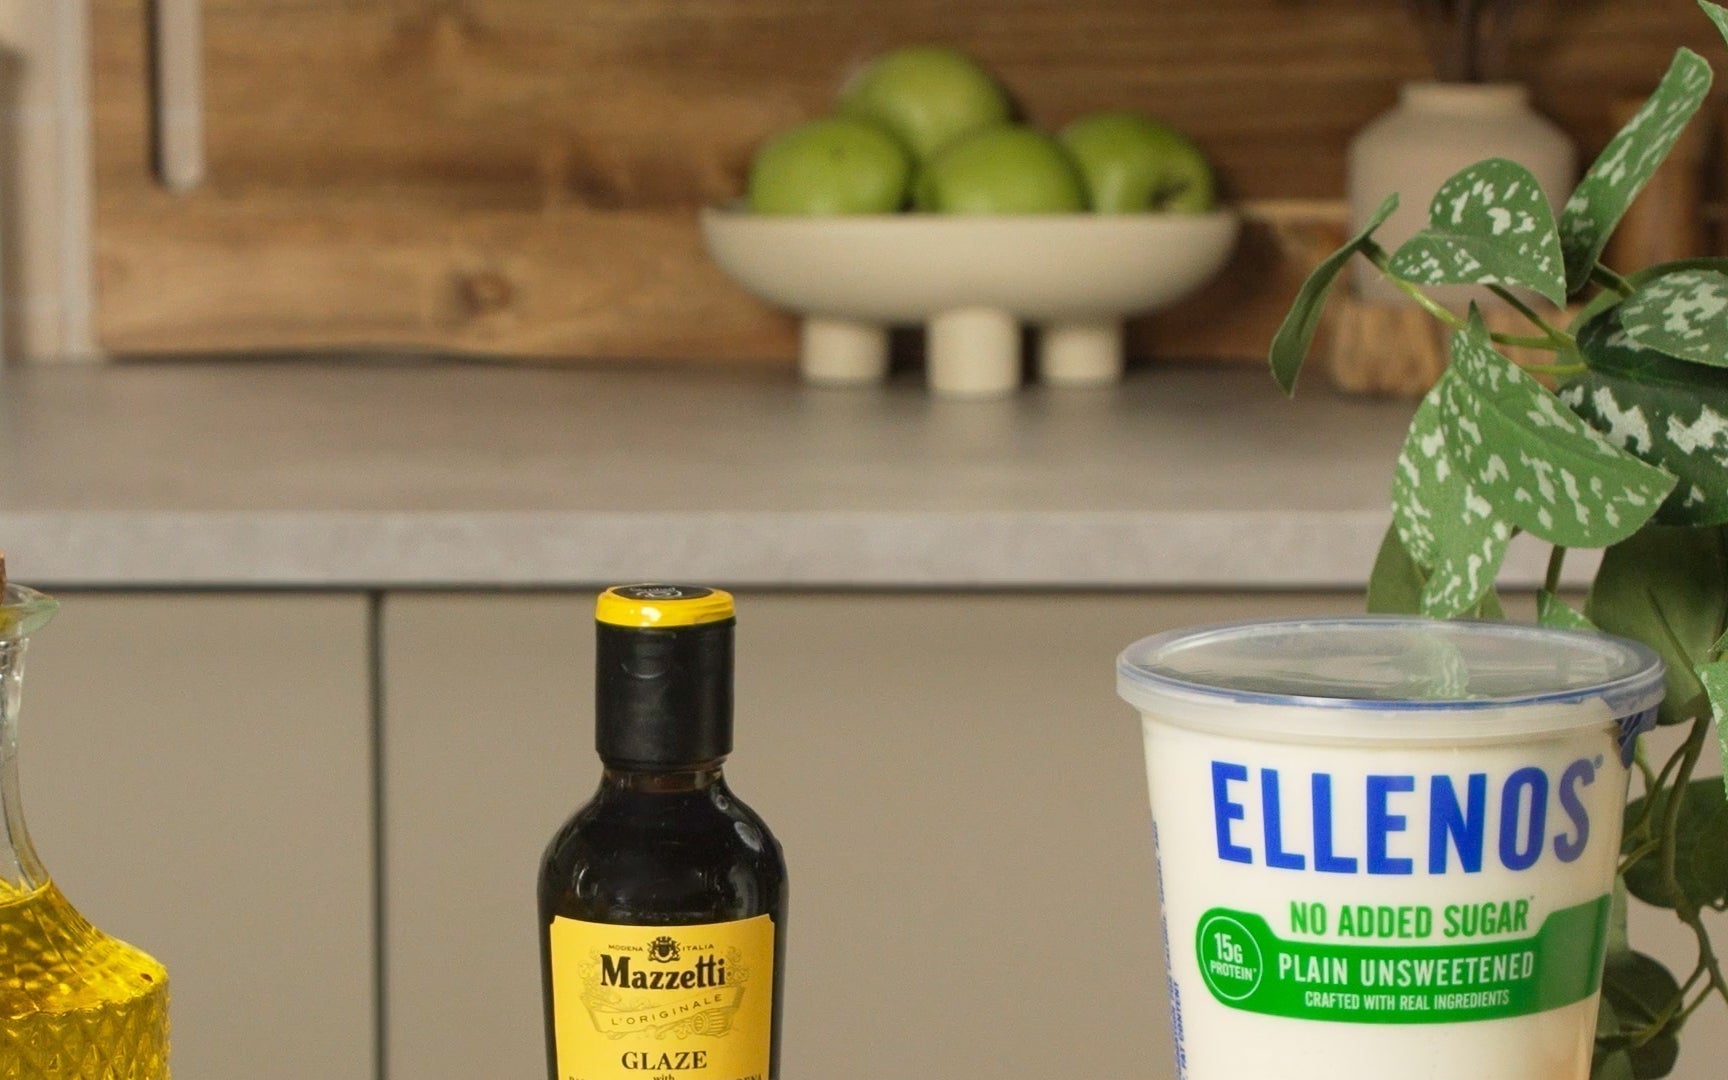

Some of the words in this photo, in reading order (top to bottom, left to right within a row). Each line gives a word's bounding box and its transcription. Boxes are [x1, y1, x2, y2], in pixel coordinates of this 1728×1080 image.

[1211, 758, 1596, 875] ELLENOS
[1289, 900, 1327, 936] NO
[1338, 905, 1433, 939] ADDED
[1443, 897, 1530, 939] SUGAR
[608, 943, 643, 952] MODENA
[682, 942, 715, 952] ITALIA
[1213, 932, 1243, 964] 15G
[600, 953, 726, 990] Mazzetti
[1210, 960, 1253, 981] PROTEIN
[1278, 952, 1348, 985] PLAIN
[1360, 951, 1534, 987] UNSWEETENED
[611, 993, 724, 1026] L'ORIGINALE
[1305, 991, 1360, 1011] CRAFTED
[1364, 994, 1395, 1012] WITH
[1400, 994, 1430, 1012] REAL
[1434, 989, 1510, 1011] INGREDIENTS
[621, 1051, 708, 1071] GLAZE
